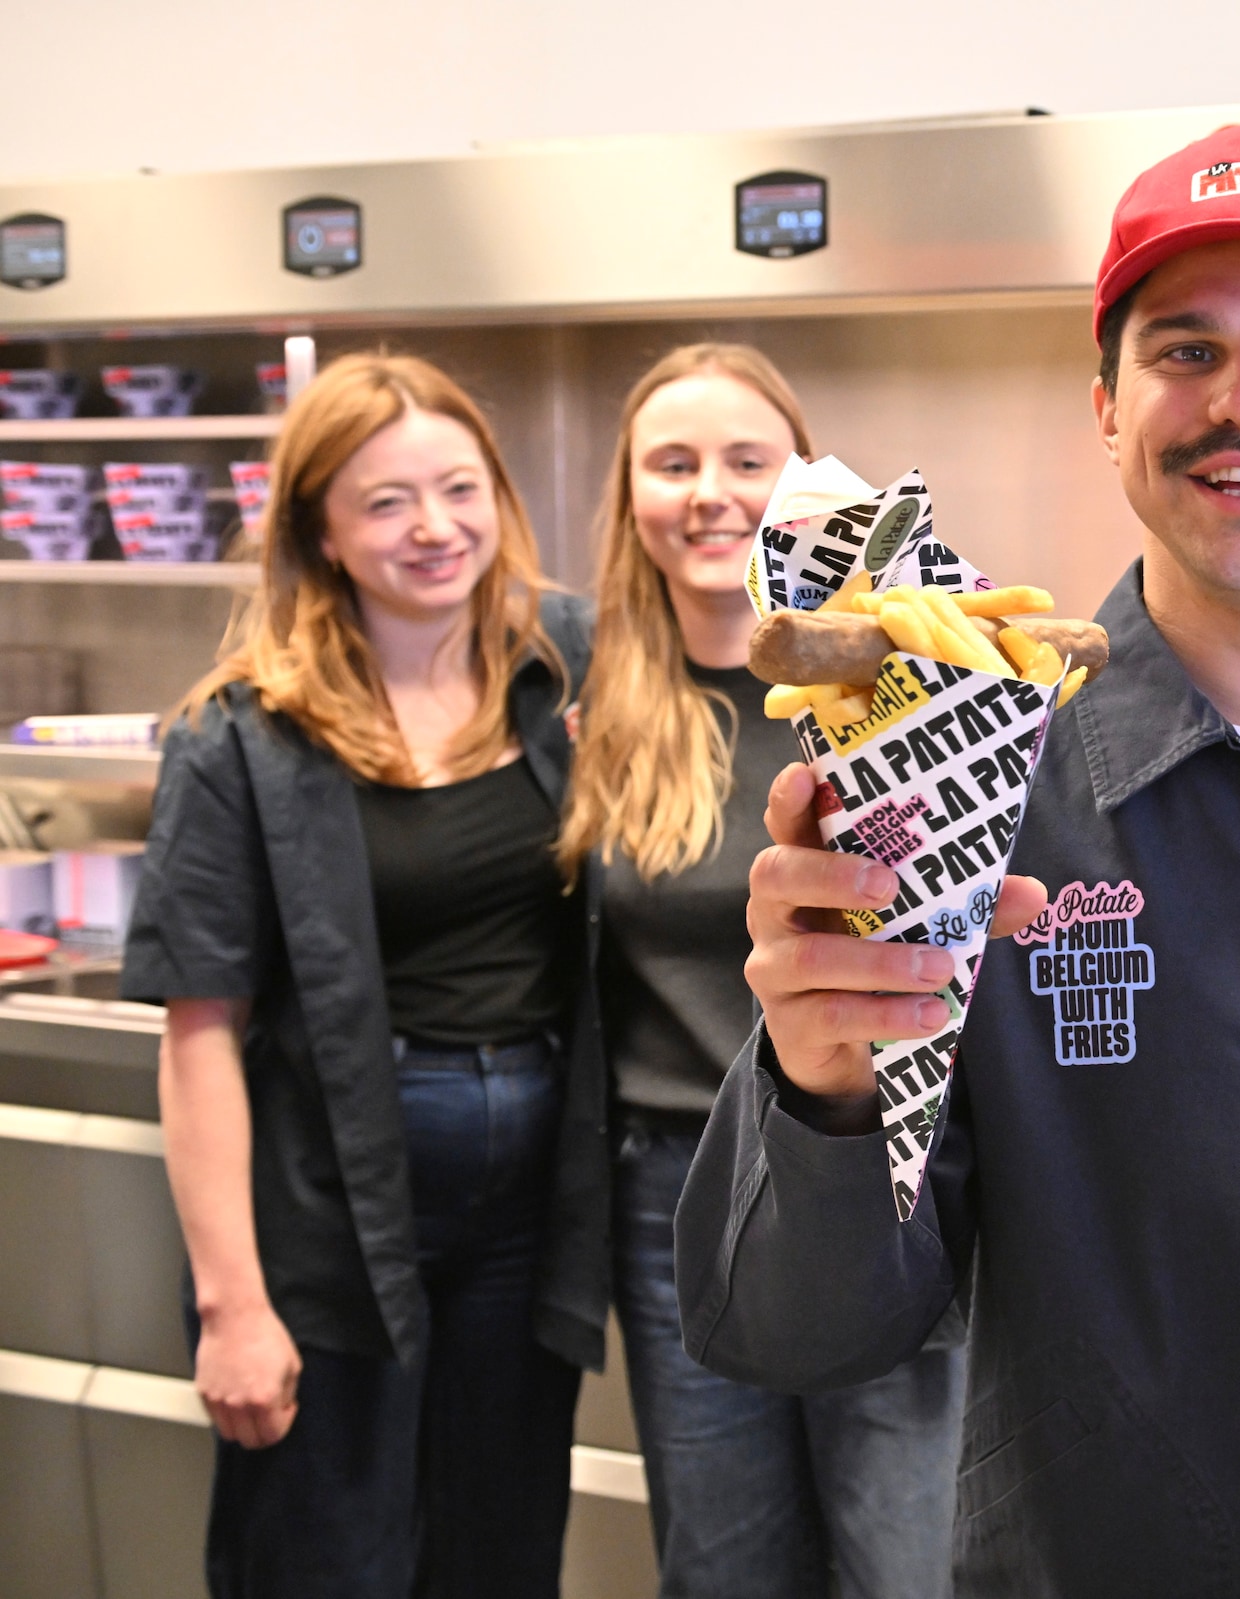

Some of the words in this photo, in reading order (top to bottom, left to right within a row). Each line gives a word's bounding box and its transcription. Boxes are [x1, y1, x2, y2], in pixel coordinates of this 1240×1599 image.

[800, 545, 857, 591] LA
[859, 661, 918, 732] ATATE
[827, 757, 891, 812] LA
[880, 678, 1044, 784] PATATE
[968, 727, 1039, 801] PAT
[855, 800, 898, 836] FROM
[863, 797, 927, 847] BELGIUM
[872, 827, 910, 857] WITH
[881, 834, 923, 868] FRIES
[912, 803, 1021, 897] PATA
[1057, 886, 1139, 923] Patate
[934, 912, 968, 947] La
[1055, 918, 1128, 951] FROM
[1036, 950, 1149, 989] BELGIUM
[1060, 987, 1128, 1023] WITH
[1061, 1023, 1130, 1060] FRIES
